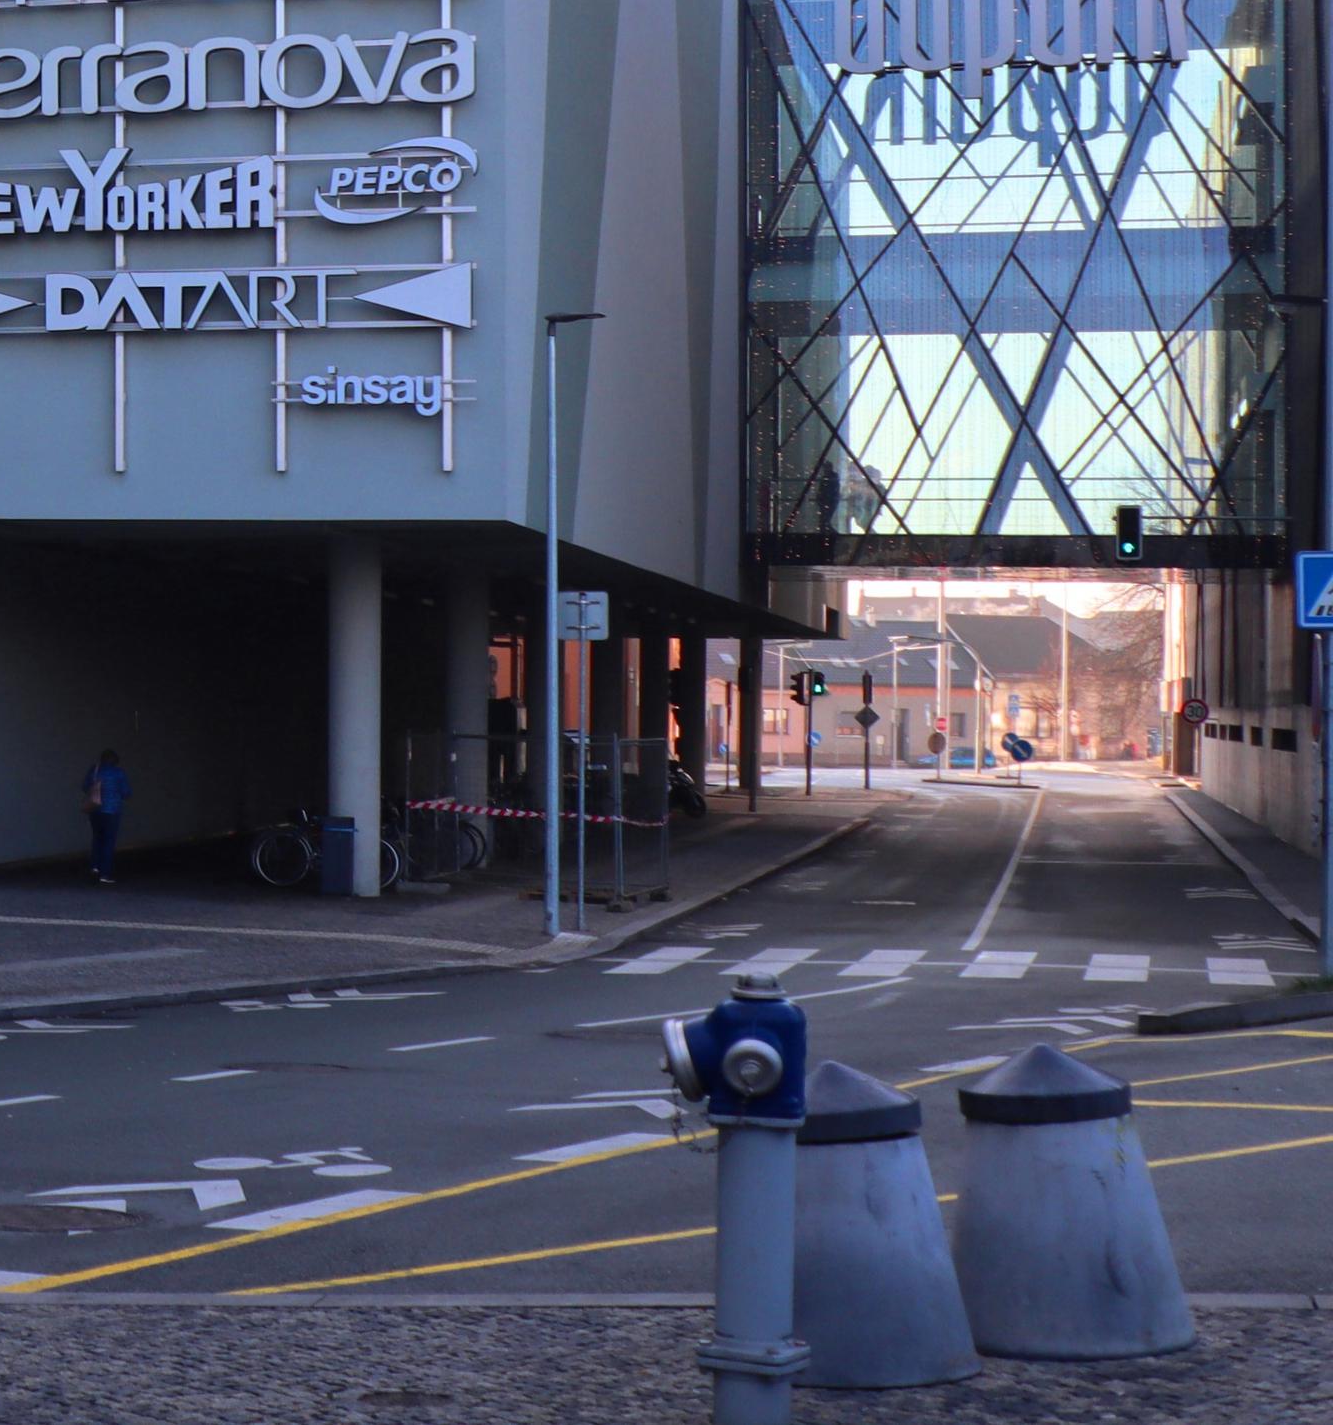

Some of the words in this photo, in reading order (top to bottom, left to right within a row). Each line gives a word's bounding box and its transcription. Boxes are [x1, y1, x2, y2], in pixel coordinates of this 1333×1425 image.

[329, 159, 463, 197] PEPCO
[44, 268, 359, 332] DATART
[300, 365, 444, 417] sinsay
[1187, 704, 1205, 718] 30
